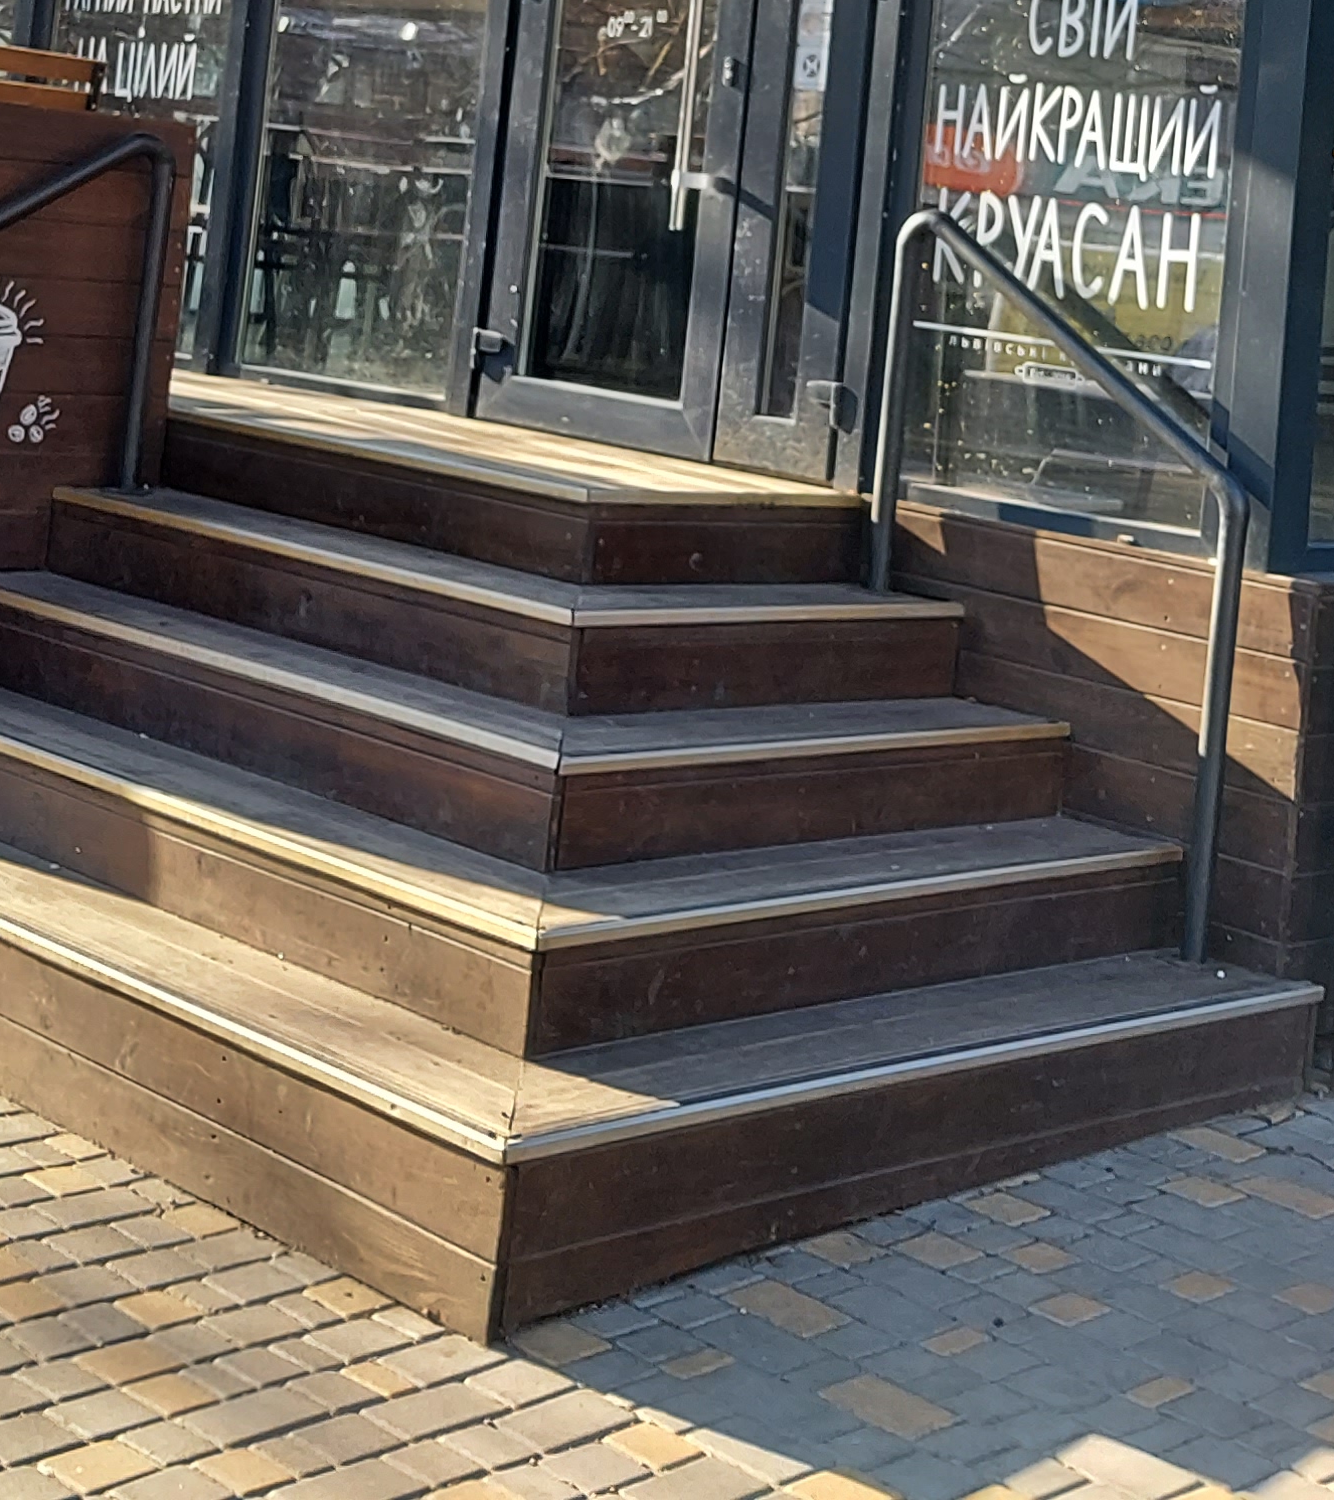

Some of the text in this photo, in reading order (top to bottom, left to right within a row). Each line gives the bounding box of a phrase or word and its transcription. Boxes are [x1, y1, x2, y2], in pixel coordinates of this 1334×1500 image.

[114, 25, 198, 103] ЦІЛИЙ
[934, 72, 1223, 182] НАЙКРАЩИЙ
[932, 186, 1202, 312] КРУАСАН
